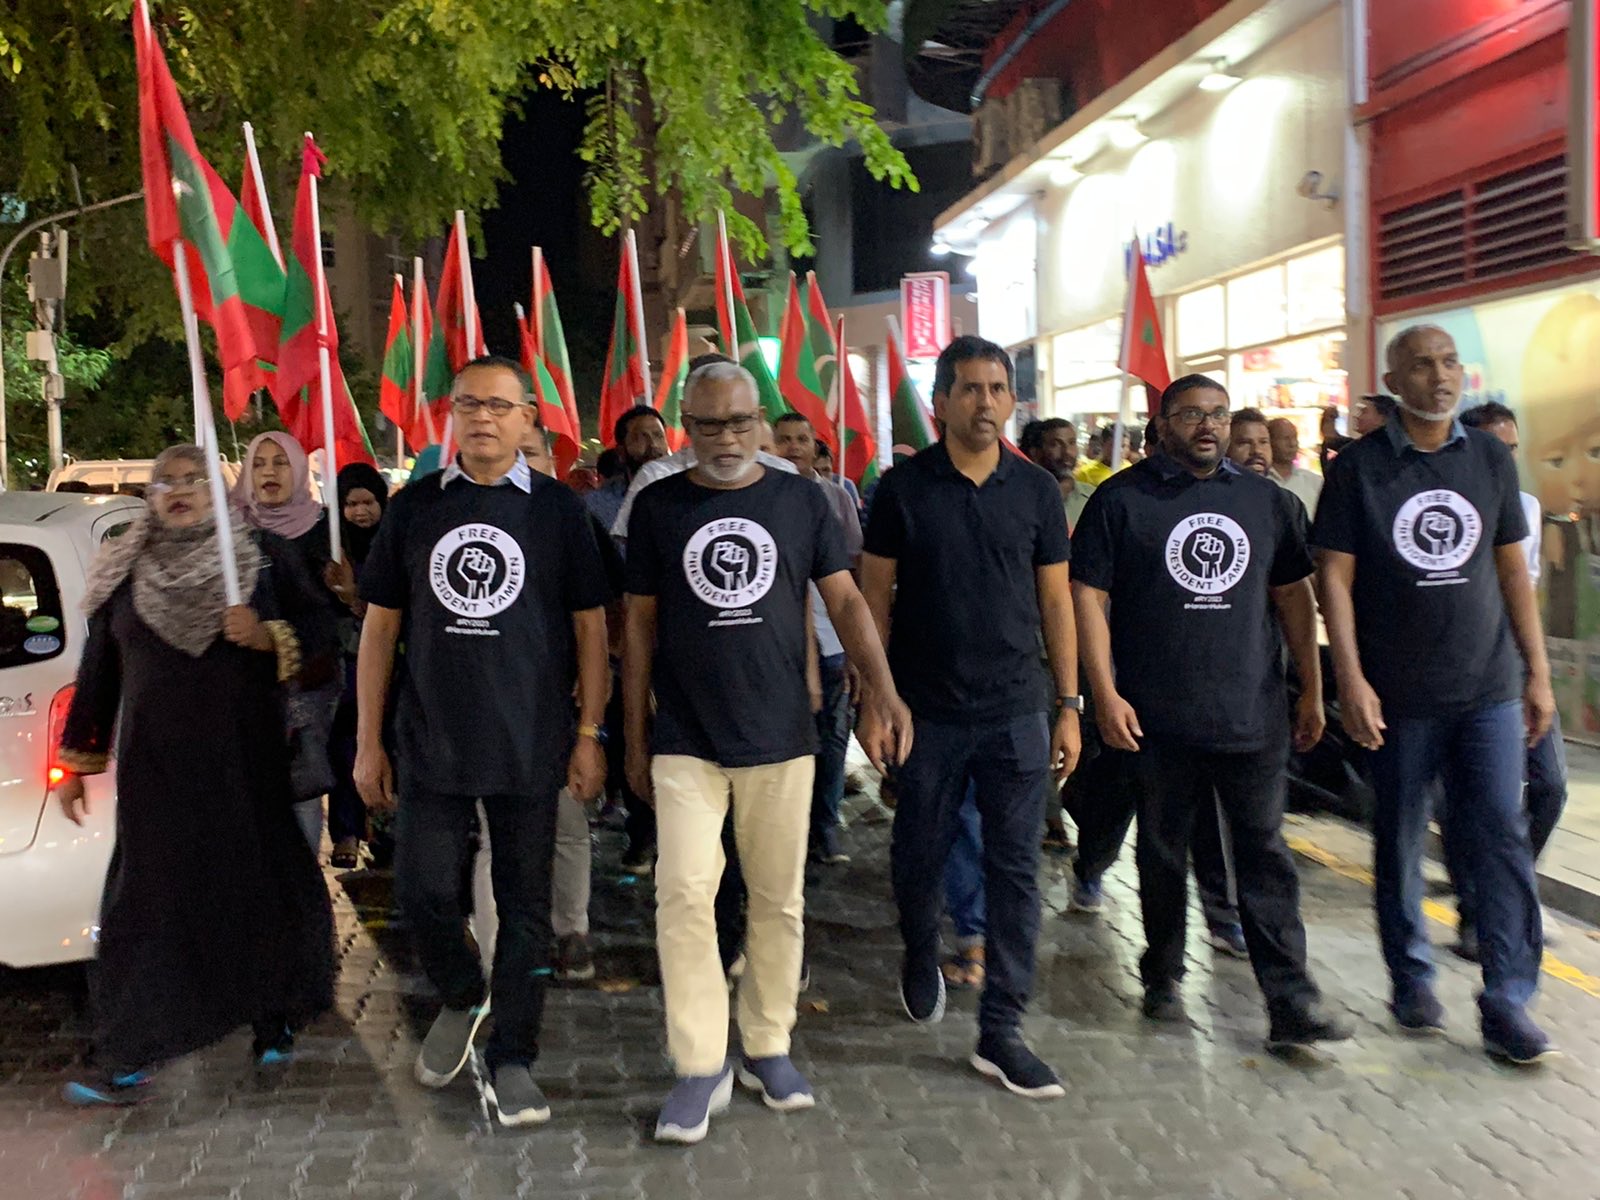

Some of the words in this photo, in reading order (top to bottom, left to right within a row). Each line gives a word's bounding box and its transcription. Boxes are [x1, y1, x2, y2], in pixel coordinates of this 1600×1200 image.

[458, 528, 500, 542] FREE
[707, 521, 748, 536] FREE
[1188, 516, 1224, 528] FREE
[688, 550, 739, 603] PRESIDENT
[747, 543, 773, 597] YAMEEN
[1170, 539, 1213, 590] PRESIDENT
[1220, 538, 1247, 586] YAMEEN
[433, 552, 479, 612] PRESIDENT
[487, 556, 520, 609] YAMEEN
